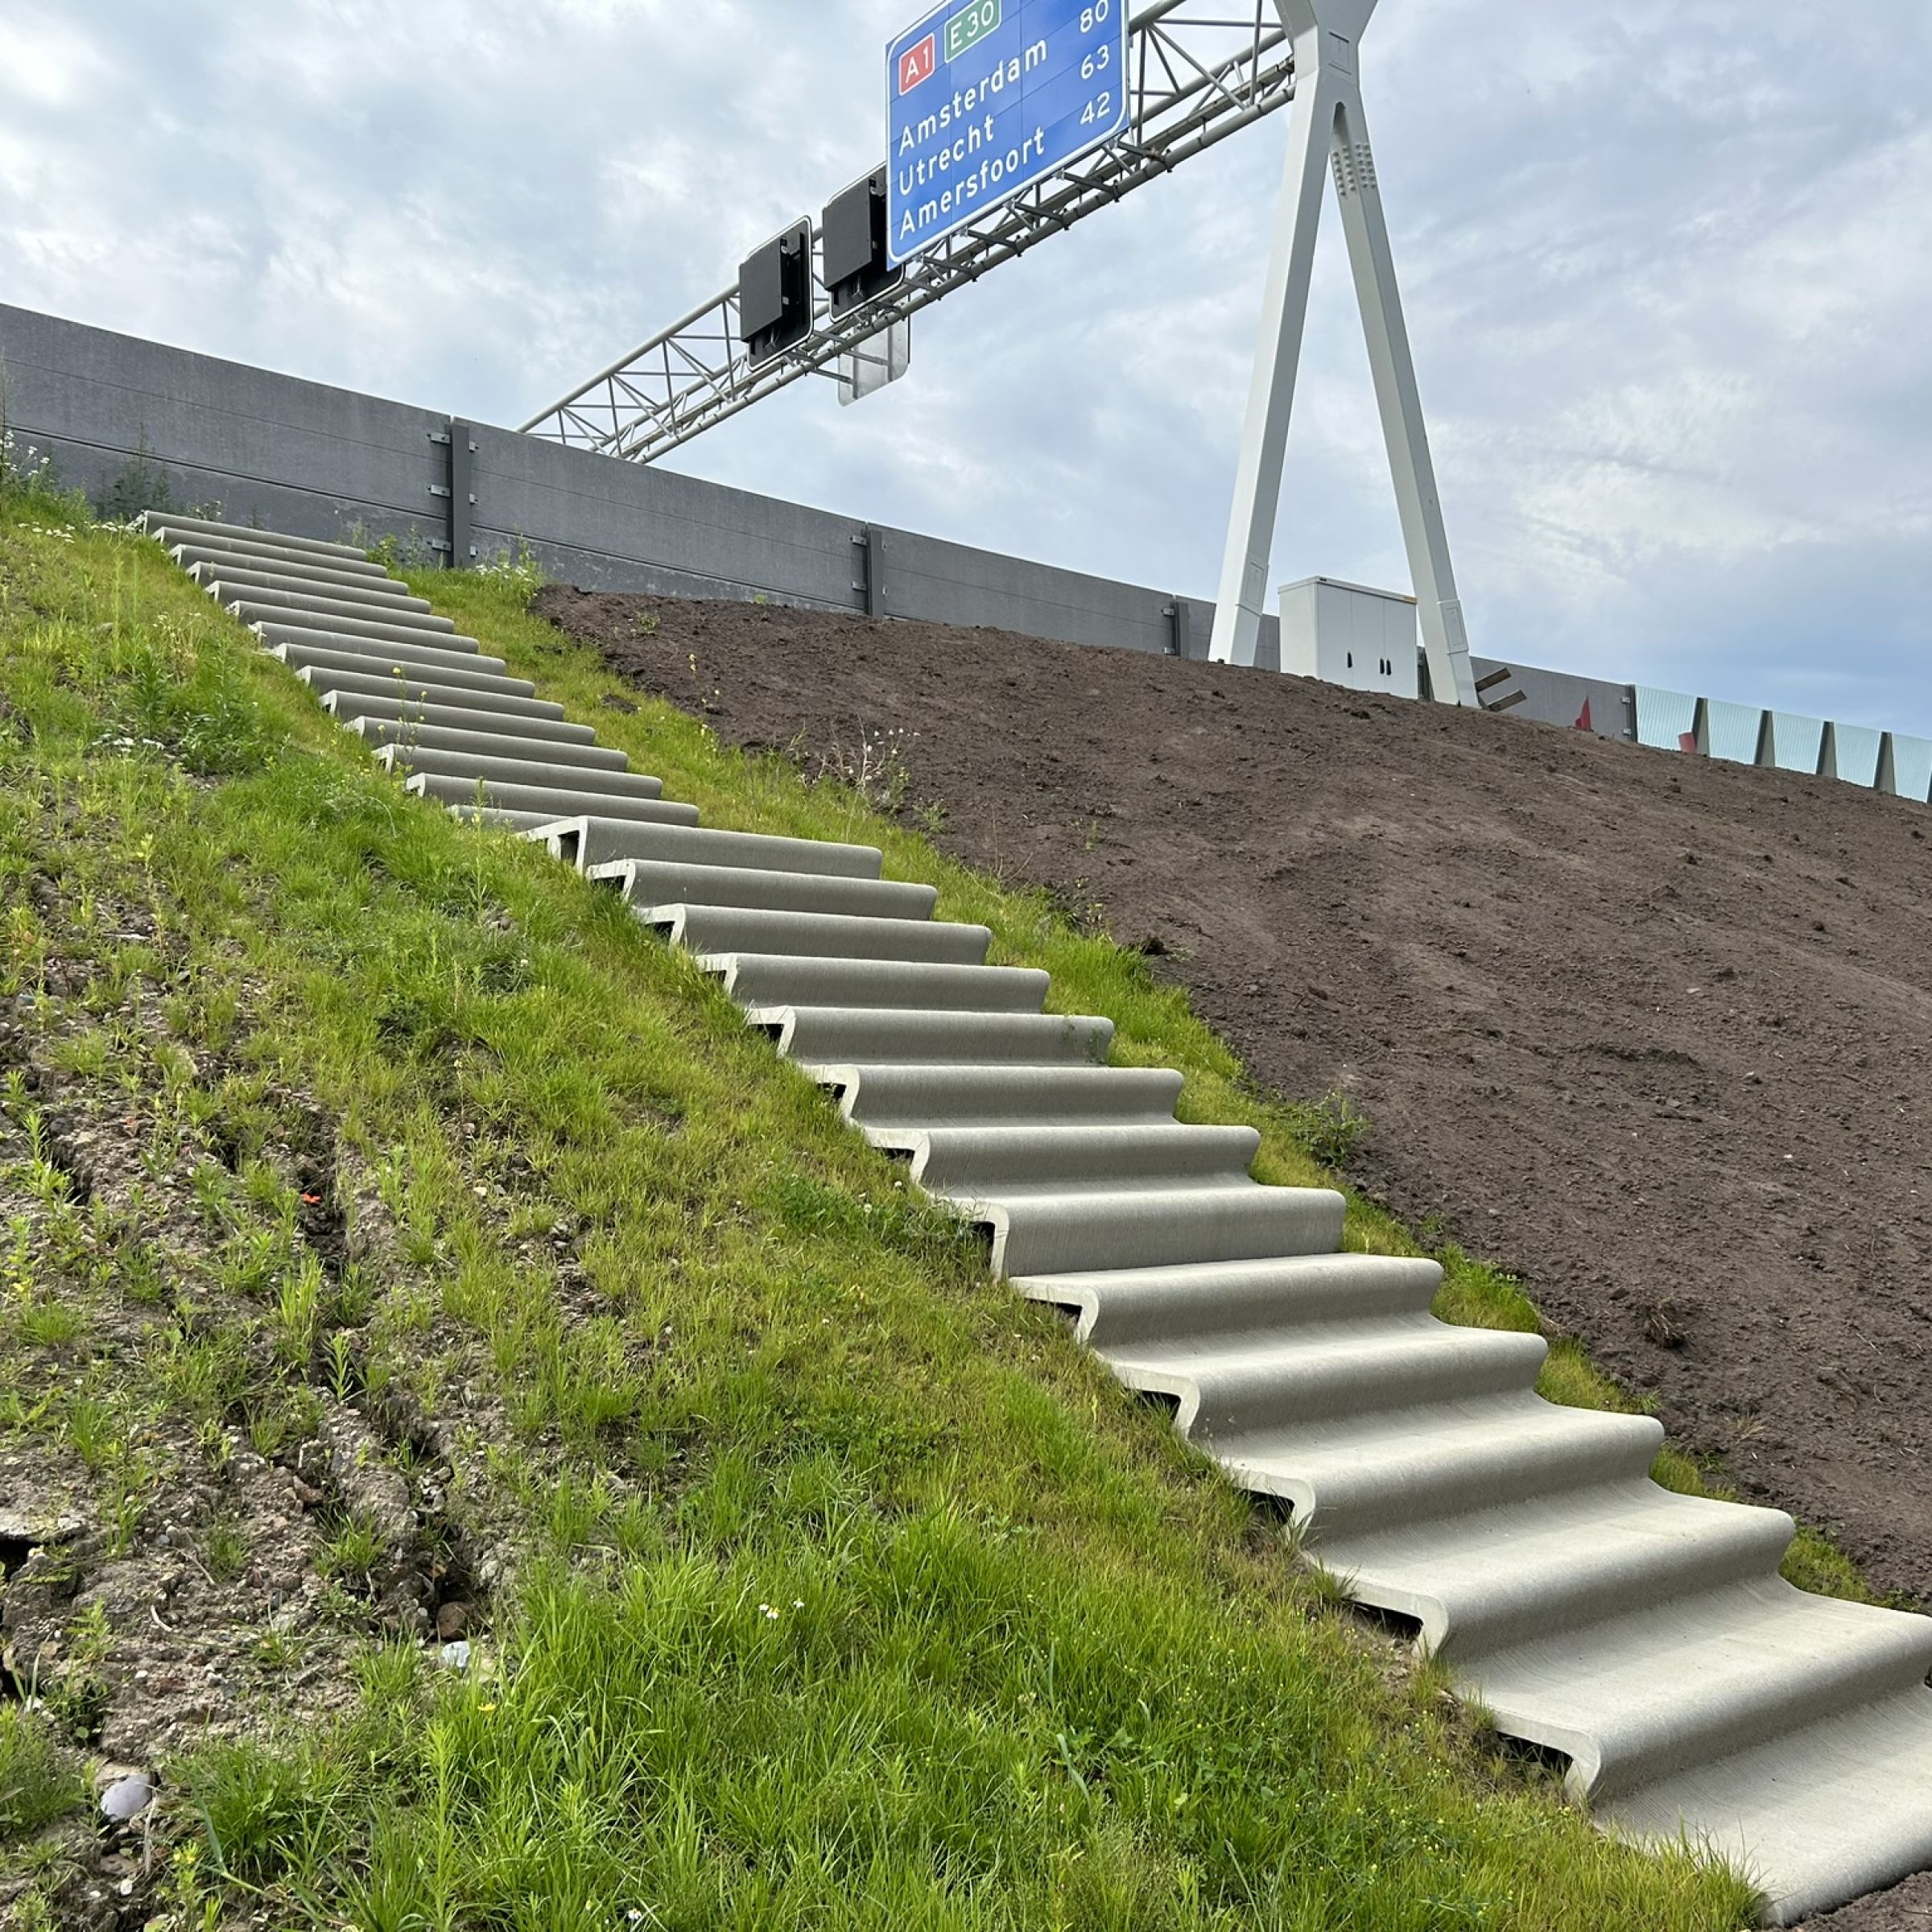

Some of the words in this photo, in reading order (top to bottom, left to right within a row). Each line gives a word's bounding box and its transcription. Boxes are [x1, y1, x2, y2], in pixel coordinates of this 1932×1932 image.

[898, 39, 1046, 157] Amsterdam
[1080, 0, 1109, 33] 80
[899, 114, 994, 196] Utrecht
[1080, 45, 1109, 79] 63
[905, 45, 929, 84] A1
[899, 126, 1045, 240] Amersfoort
[1080, 92, 1110, 125] 42
